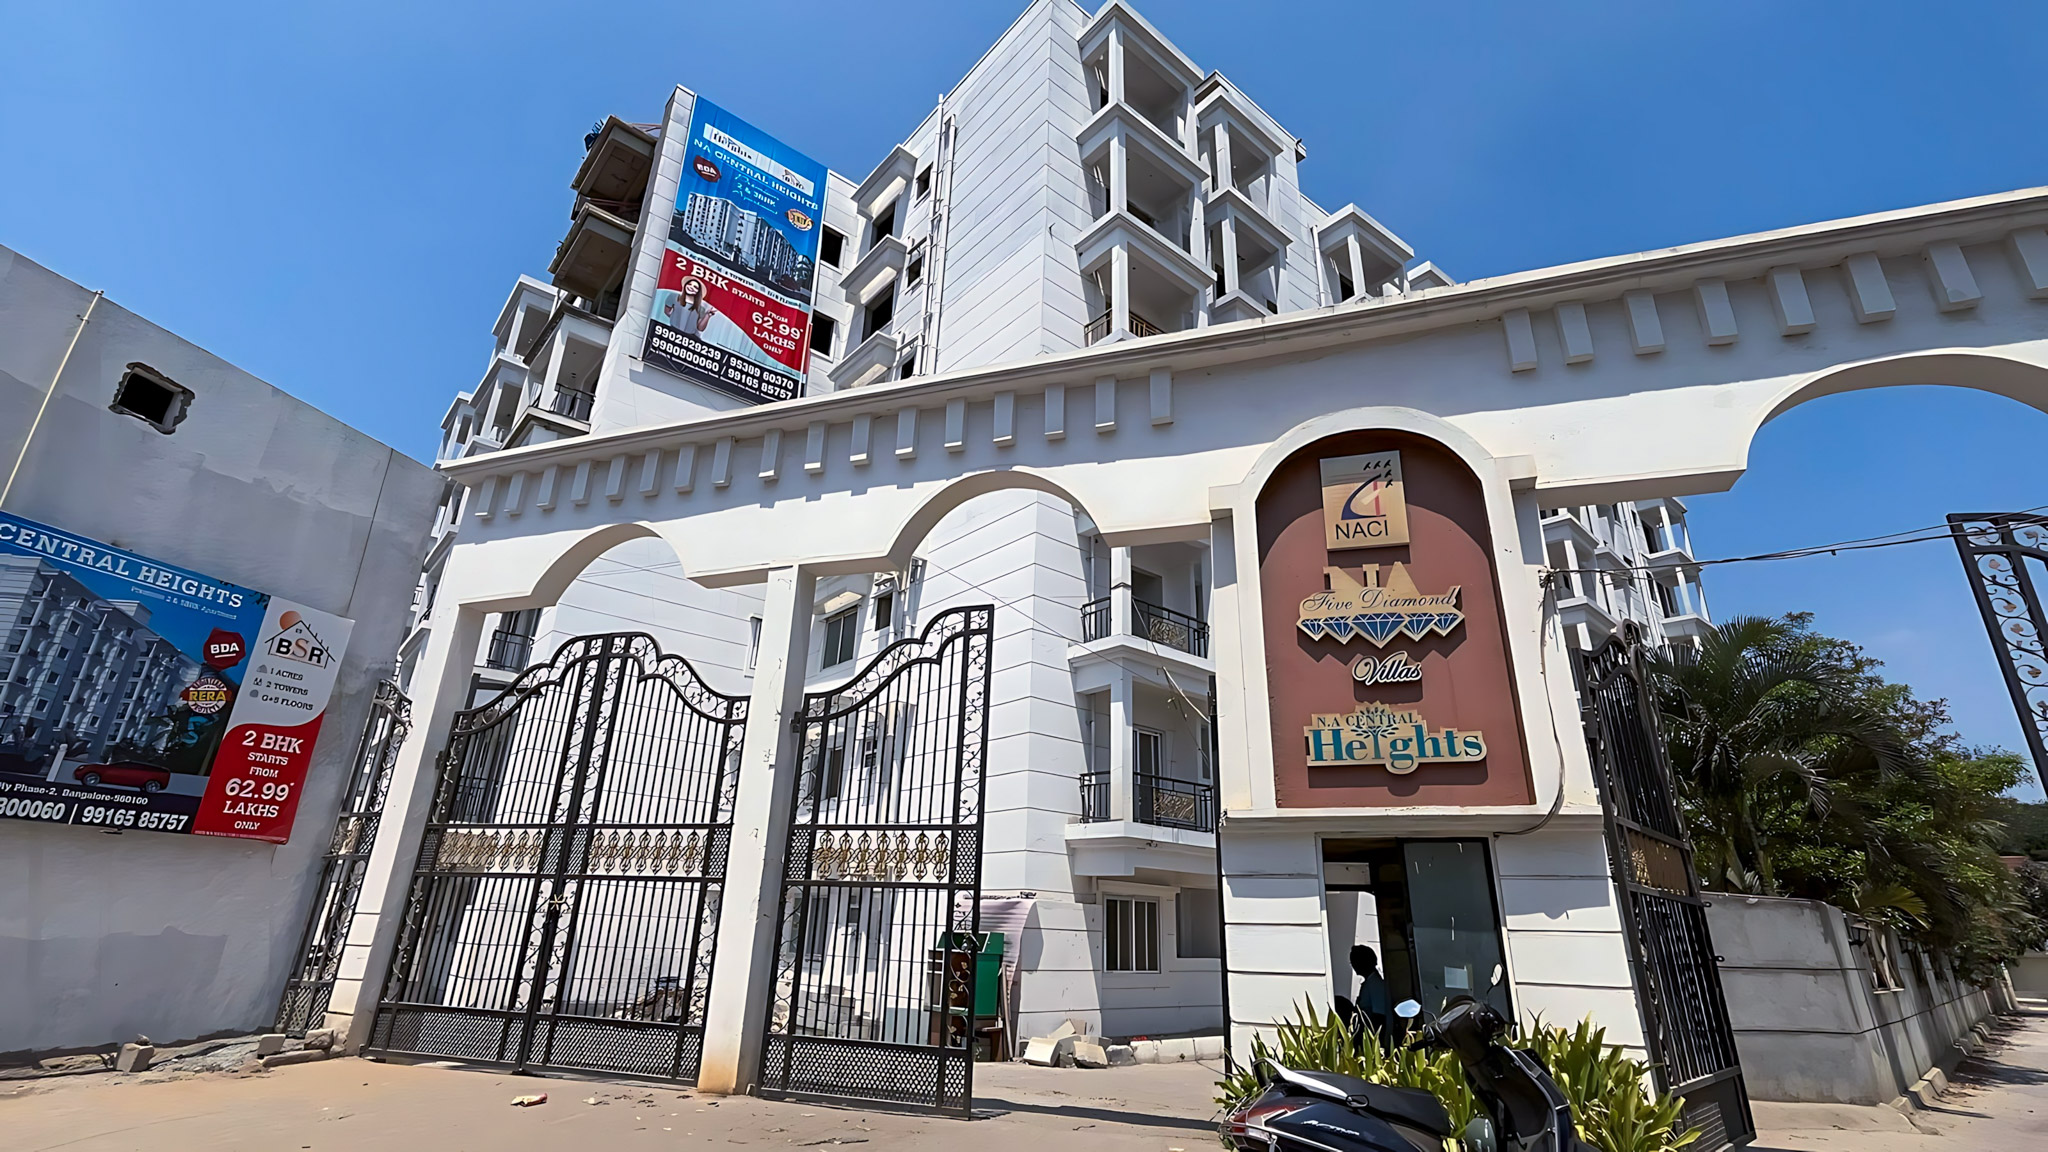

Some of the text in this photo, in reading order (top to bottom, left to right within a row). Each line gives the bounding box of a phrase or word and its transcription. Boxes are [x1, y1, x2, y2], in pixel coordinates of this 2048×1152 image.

[675, 257, 688, 271] 2
[690, 263, 729, 291] BHK
[753, 326, 796, 351] LAKHS
[1335, 519, 1389, 540] NACI
[0, 523, 244, 608] CENTRAL HEIGHTS
[1302, 586, 1458, 612] Five Diamond
[210, 642, 240, 654] BDA
[275, 637, 324, 664] BSR
[275, 669, 304, 681] ACRES
[1352, 651, 1422, 686] Villas
[188, 690, 227, 702] RERA
[274, 682, 309, 696] TOWERS
[280, 698, 314, 711] FLOORS
[1345, 712, 1418, 728] CENTRAL
[242, 730, 304, 754] 2 BHK
[1308, 724, 1483, 770] Heights
[247, 752, 289, 766] STARTS
[249, 766, 279, 778] FROM
[81, 805, 136, 827] 99165
[137, 812, 189, 831] 85757
[223, 800, 280, 818] LAKHS
[234, 820, 261, 830] ONLY
